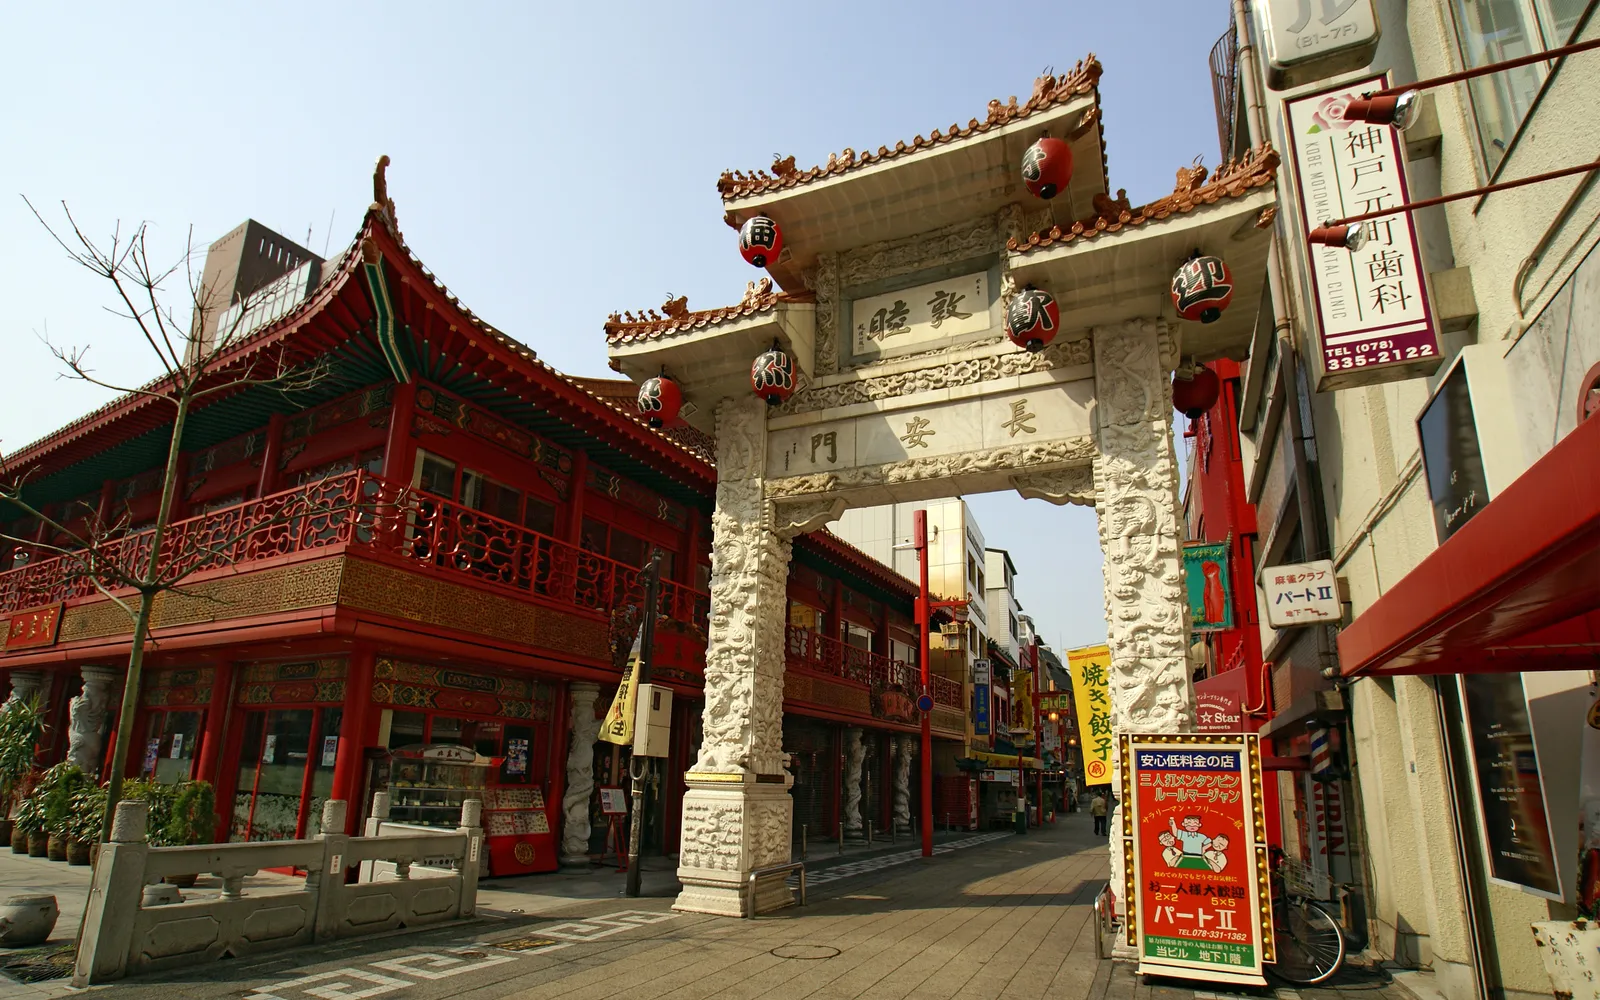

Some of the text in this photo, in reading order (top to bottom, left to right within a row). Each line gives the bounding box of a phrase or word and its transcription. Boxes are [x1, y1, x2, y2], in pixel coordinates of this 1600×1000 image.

[1306, 141, 1322, 168] KOBE
[1310, 171, 1331, 224] MOTOMAC
[1343, 126, 1412, 315] 神戸元町歯科
[1172, 256, 1233, 312] 迎
[1327, 280, 1347, 320] CLINIC
[1325, 340, 1394, 358] TEL (078)
[1327, 344, 1434, 371] 335-2122
[1275, 571, 1326, 585] 麻雀クラブ
[1285, 609, 1301, 617] 地下
[1081, 662, 1113, 762] 焼き餃子
[1214, 712, 1240, 723] Star
[1140, 754, 1234, 768] 安心低料金の店
[1154, 788, 1241, 803] ルールマージャン
[1153, 871, 1238, 882] 初めての方でもどうぞお気軽に
[1148, 881, 1245, 899] お一人様大歓迎
[1156, 945, 1241, 965] 当ビル 地下1階
